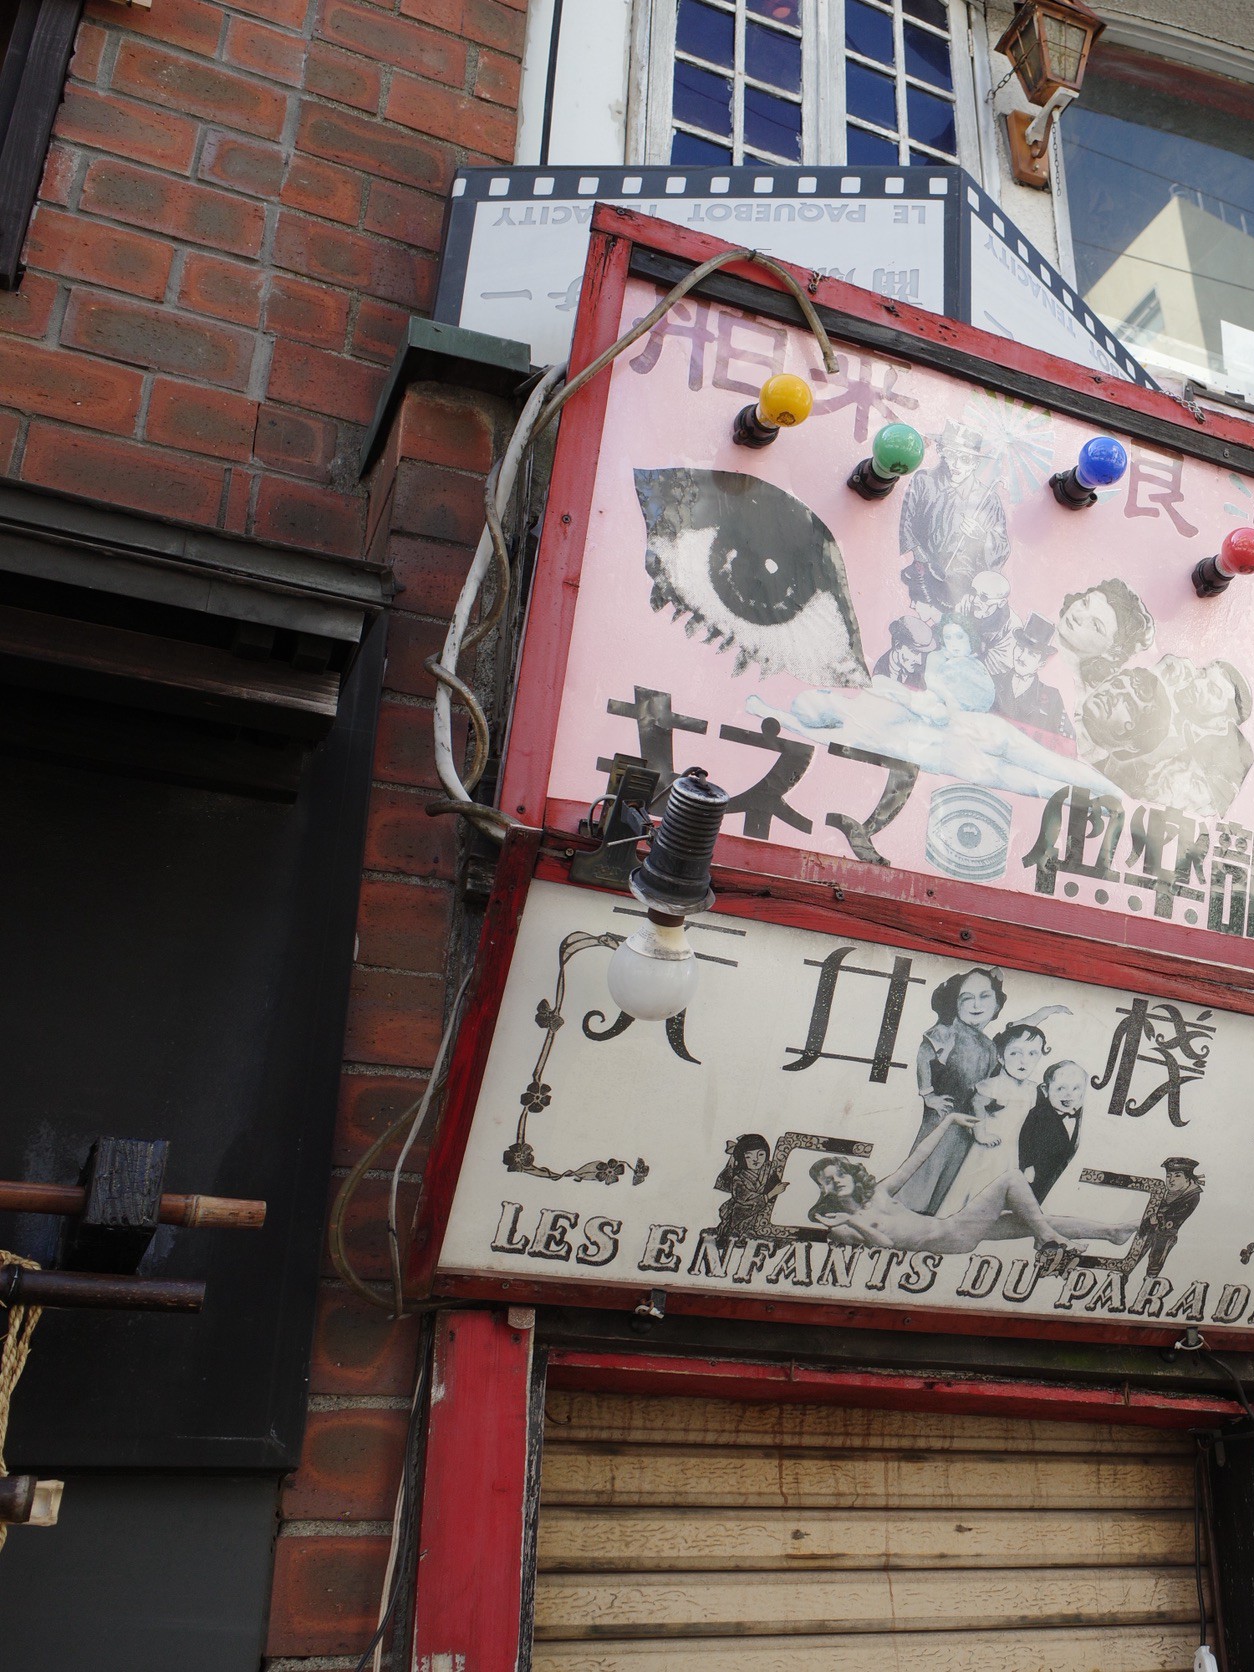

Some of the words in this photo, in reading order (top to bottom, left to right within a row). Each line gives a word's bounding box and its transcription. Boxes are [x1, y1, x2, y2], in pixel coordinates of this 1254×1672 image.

[687, 201, 867, 225] PAQUEBOT
[895, 203, 927, 225] LE
[983, 233, 1077, 339] TENACITY
[490, 1200, 625, 1267] LES
[636, 1222, 945, 1295] ENFANTS
[955, 1251, 1045, 1301] DU
